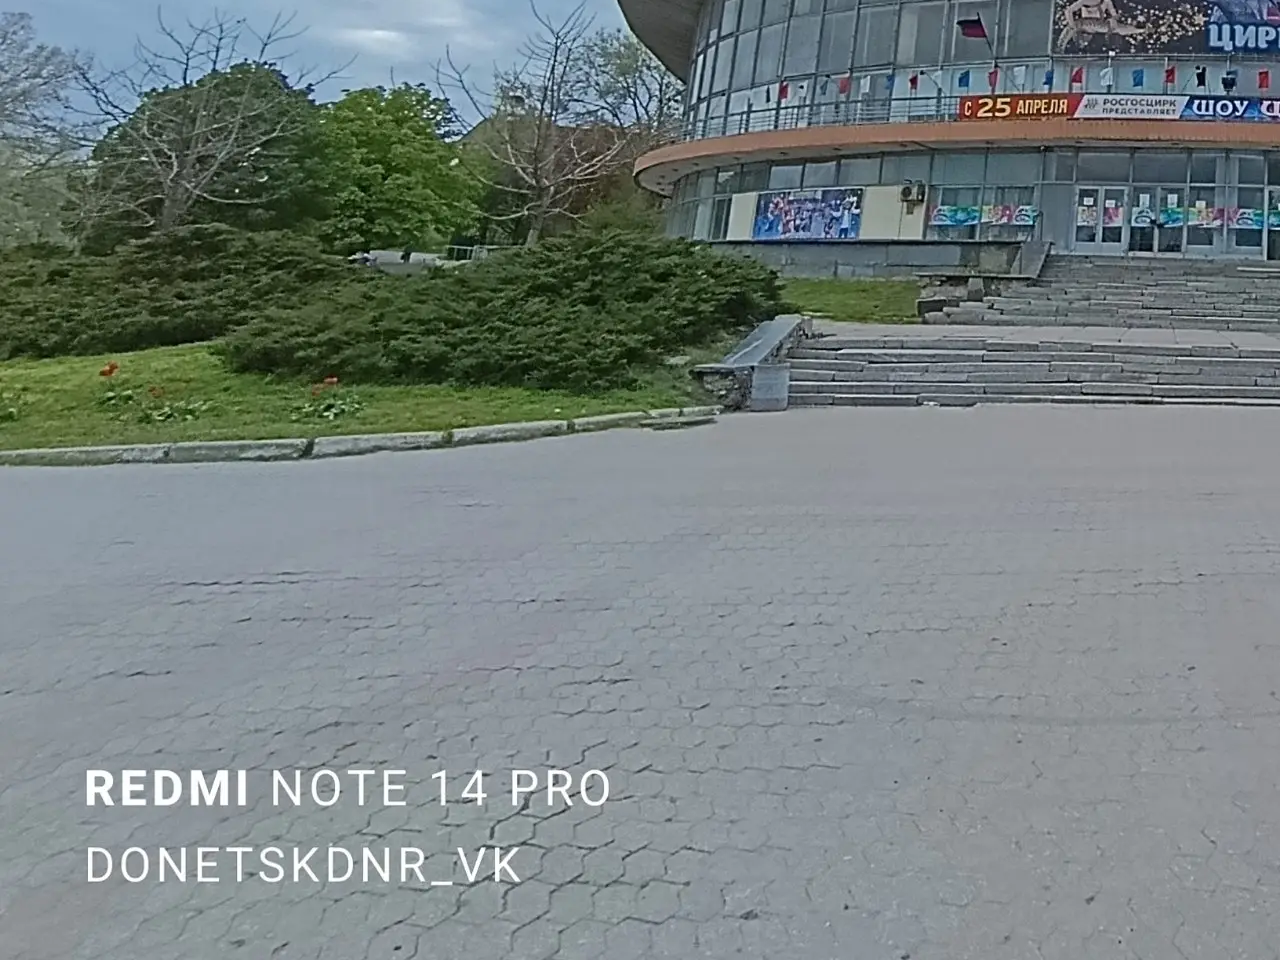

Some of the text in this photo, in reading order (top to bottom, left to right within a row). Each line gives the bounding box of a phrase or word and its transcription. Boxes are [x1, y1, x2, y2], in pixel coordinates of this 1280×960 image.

[964, 98, 1068, 117] С 25 АПРЕЛЯ
[1103, 98, 1177, 108] РОСГОСЦИРК
[1192, 99, 1249, 116] ШОУ
[1102, 107, 1177, 115] ПРЕДСТАВЛЯЕТ
